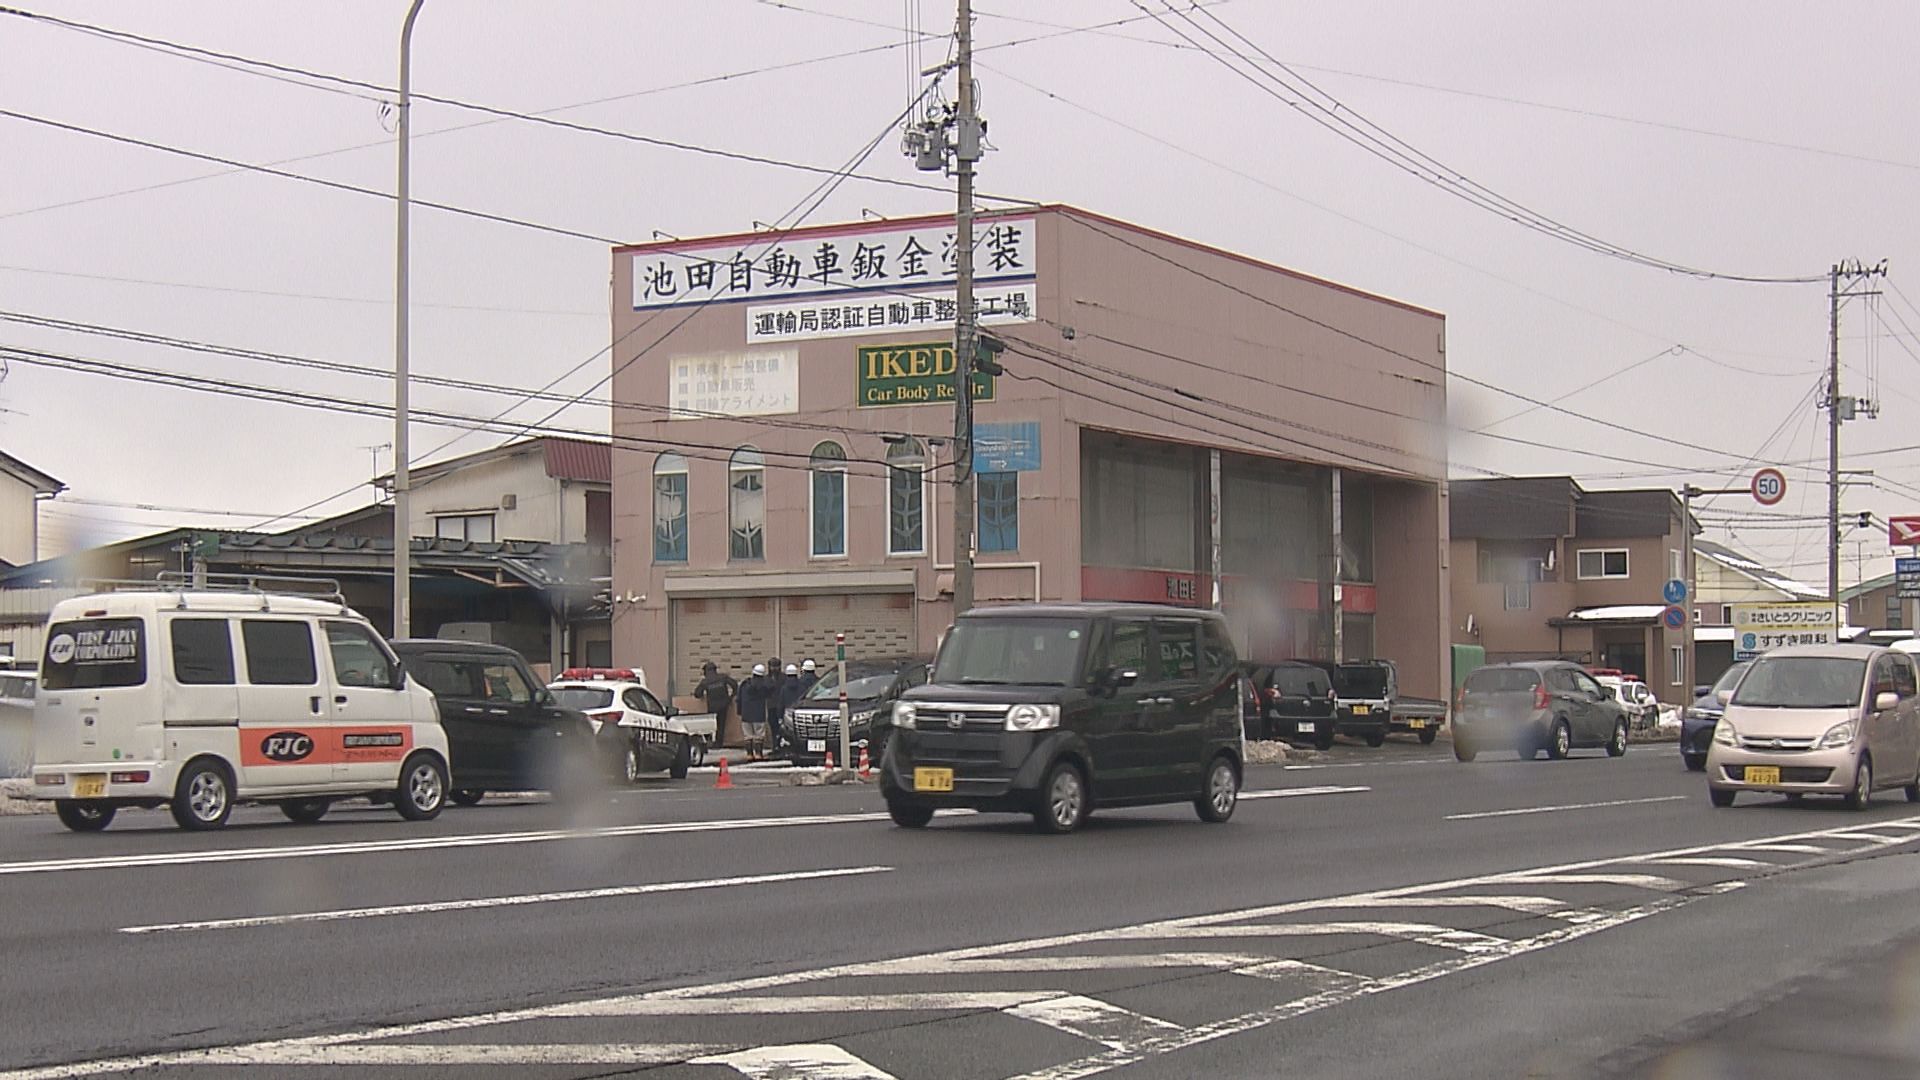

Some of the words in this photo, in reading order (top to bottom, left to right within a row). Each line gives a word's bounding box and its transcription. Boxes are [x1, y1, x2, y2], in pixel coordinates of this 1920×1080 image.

[866, 347, 979, 379] IKED
[867, 387, 893, 401] Car
[896, 384, 932, 400] Body
[937, 383, 985, 397] Reir
[1759, 478, 1779, 495] 50
[77, 630, 105, 645] FIRST
[107, 628, 138, 644] JAPAN
[1760, 632, 1828, 647] すずき眼科
[639, 728, 667, 744] POLICE
[266, 735, 310, 757] FJC
